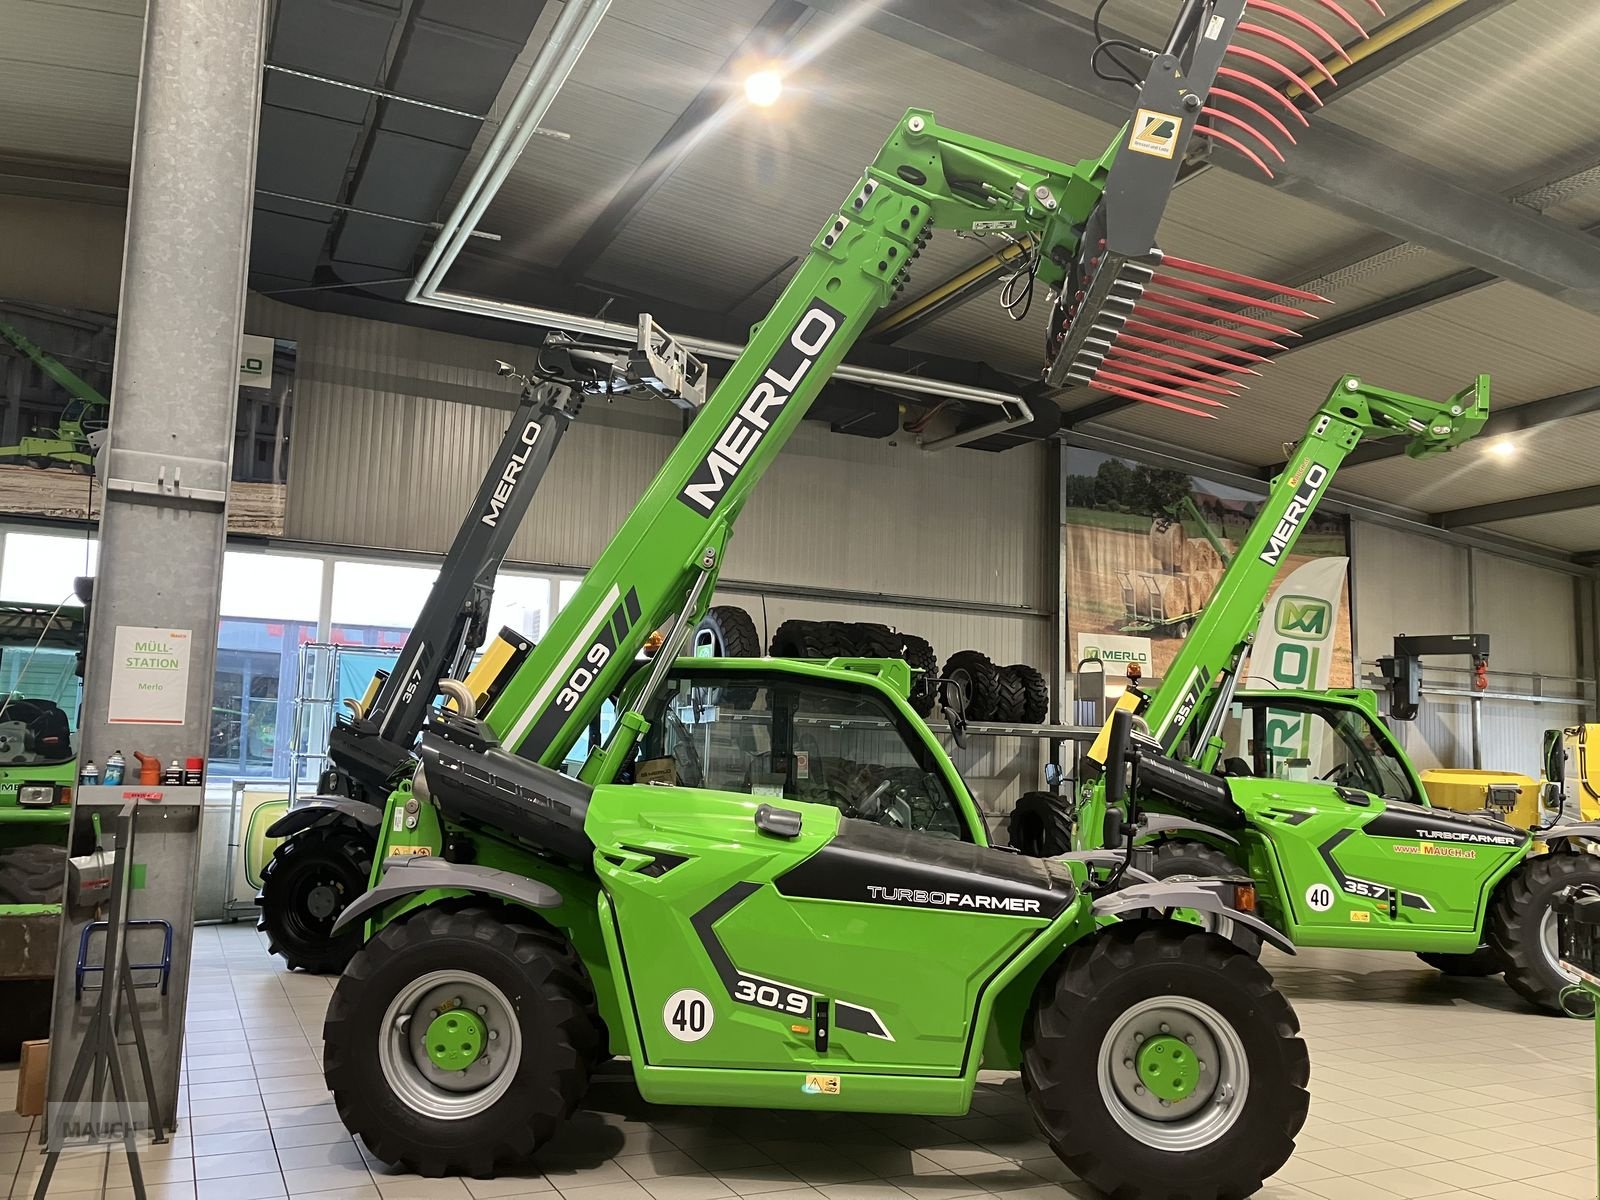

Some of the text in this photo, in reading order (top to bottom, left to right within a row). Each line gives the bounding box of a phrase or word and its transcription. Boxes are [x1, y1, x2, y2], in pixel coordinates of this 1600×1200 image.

[683, 308, 836, 510] MERLO
[482, 421, 541, 527] MERLO
[1260, 464, 1327, 565] MERLO
[135, 640, 173, 653] MÜLL-
[1102, 650, 1147, 662] MERLO
[126, 657, 179, 669] STATION
[556, 643, 610, 712] 30.9
[138, 683, 163, 691] Merlo
[402, 669, 421, 704] 35.7
[1174, 692, 1195, 726] 35.7
[1416, 829, 1515, 845] TURBOFARMER
[867, 885, 1041, 913] TURBOFARMER
[1311, 889, 1329, 907] 40
[1344, 881, 1385, 898] 35.7
[734, 980, 808, 1014] 30.9
[672, 999, 705, 1032] 40
